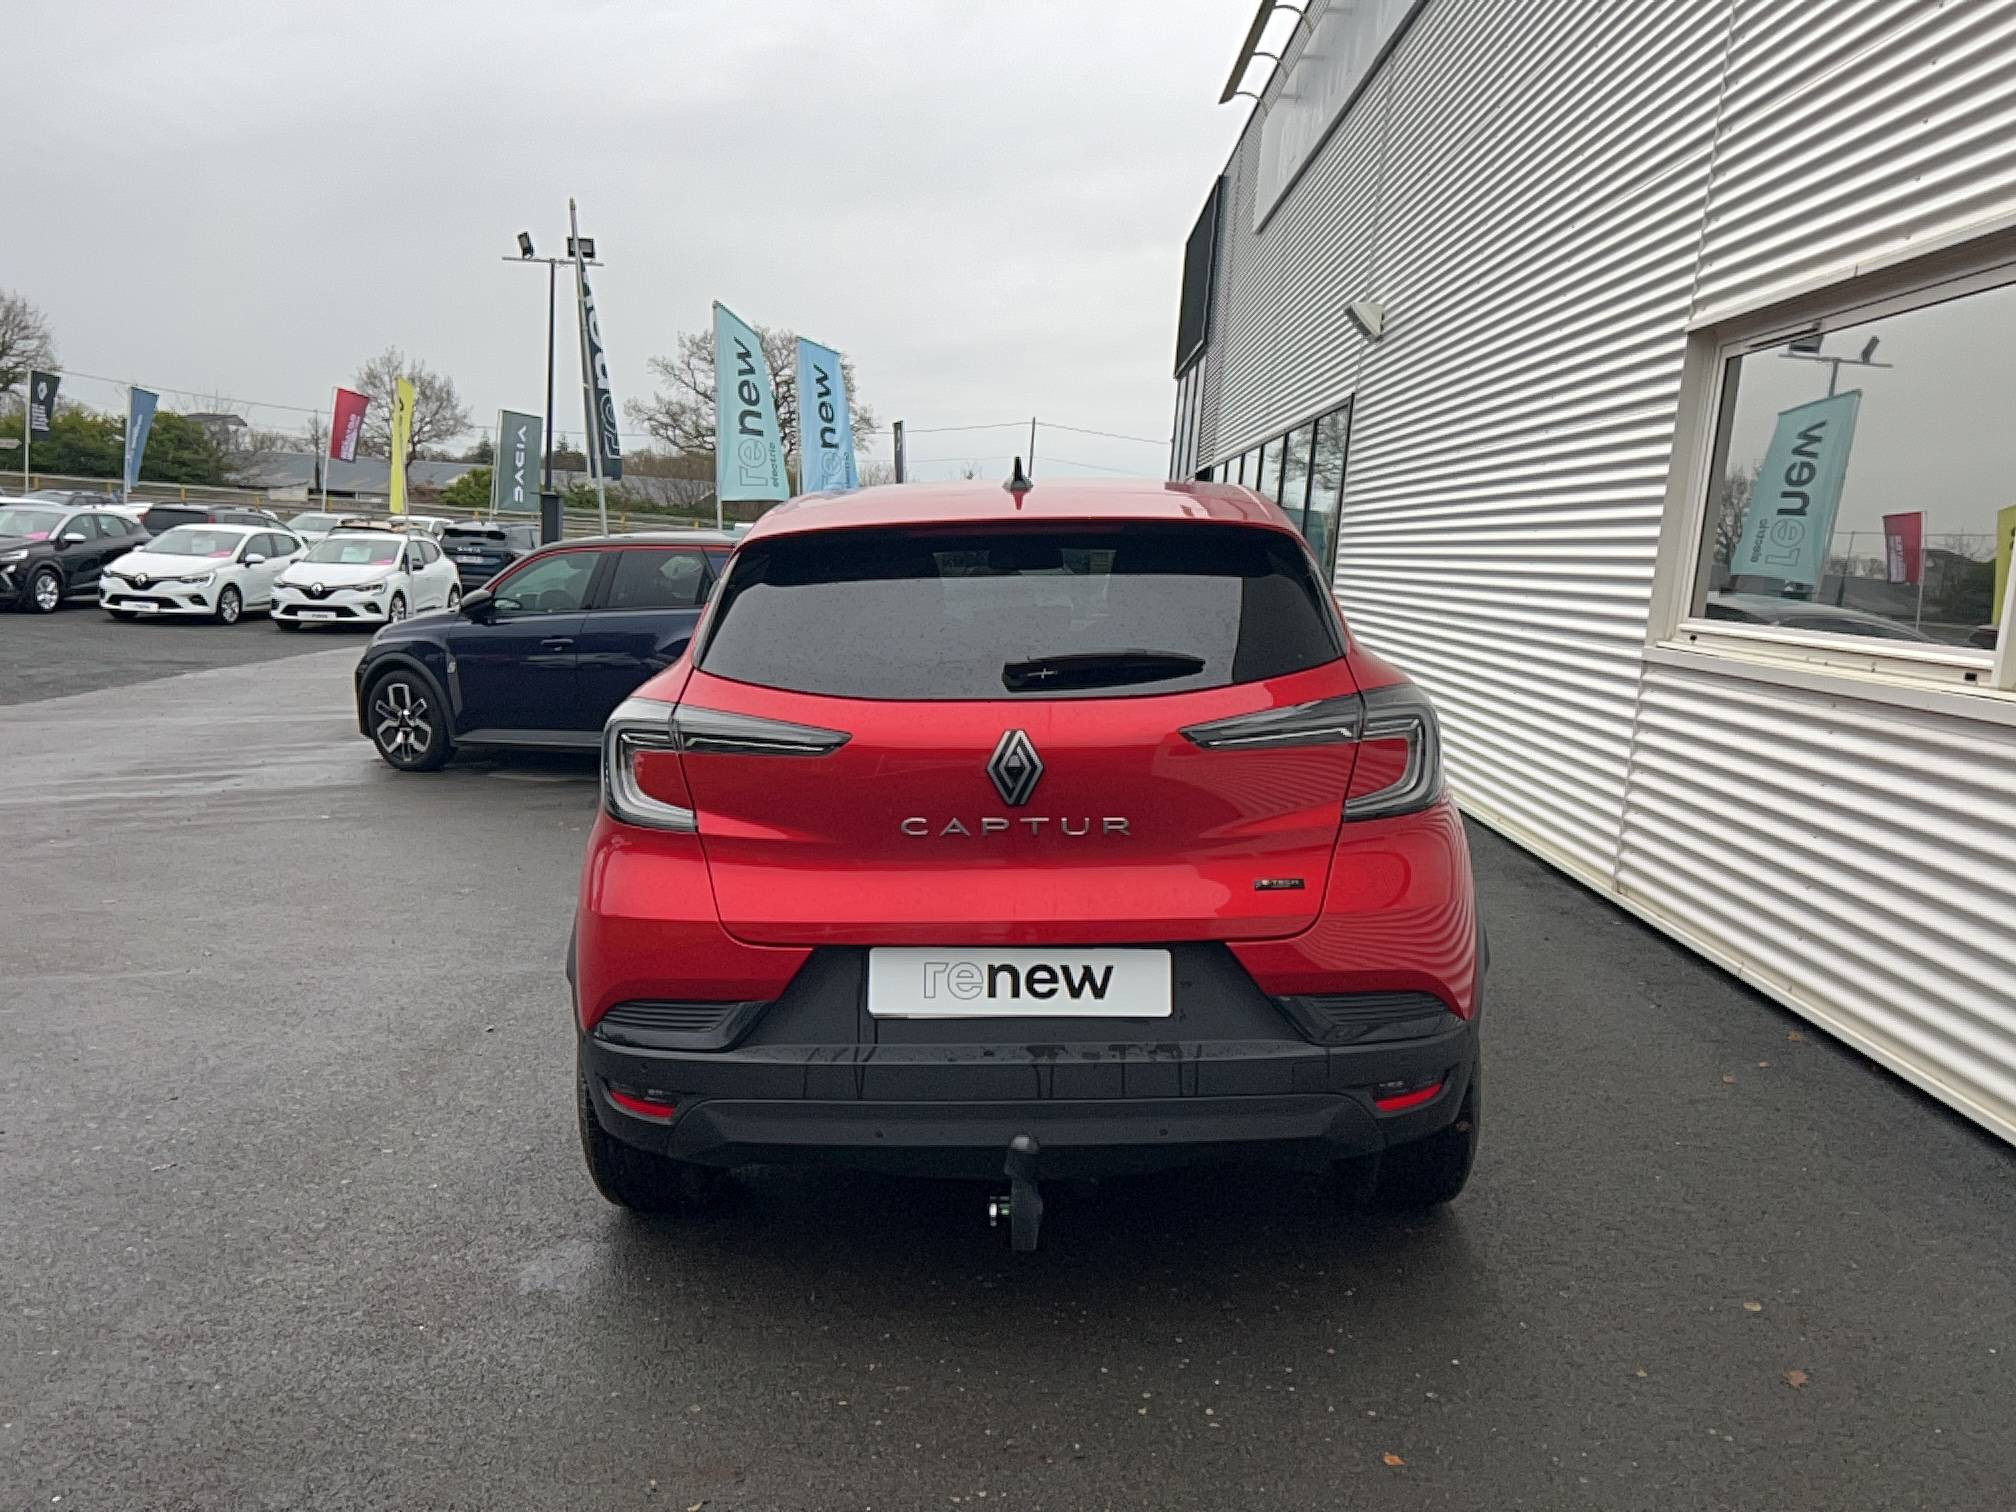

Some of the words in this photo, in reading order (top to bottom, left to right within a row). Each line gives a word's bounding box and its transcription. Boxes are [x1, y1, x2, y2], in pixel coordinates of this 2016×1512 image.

[734, 336, 769, 488] renew
[813, 364, 842, 489] renew
[512, 425, 527, 503] DACIA
[900, 816, 1132, 837] CAPTUR
[923, 961, 1115, 1001] renew
